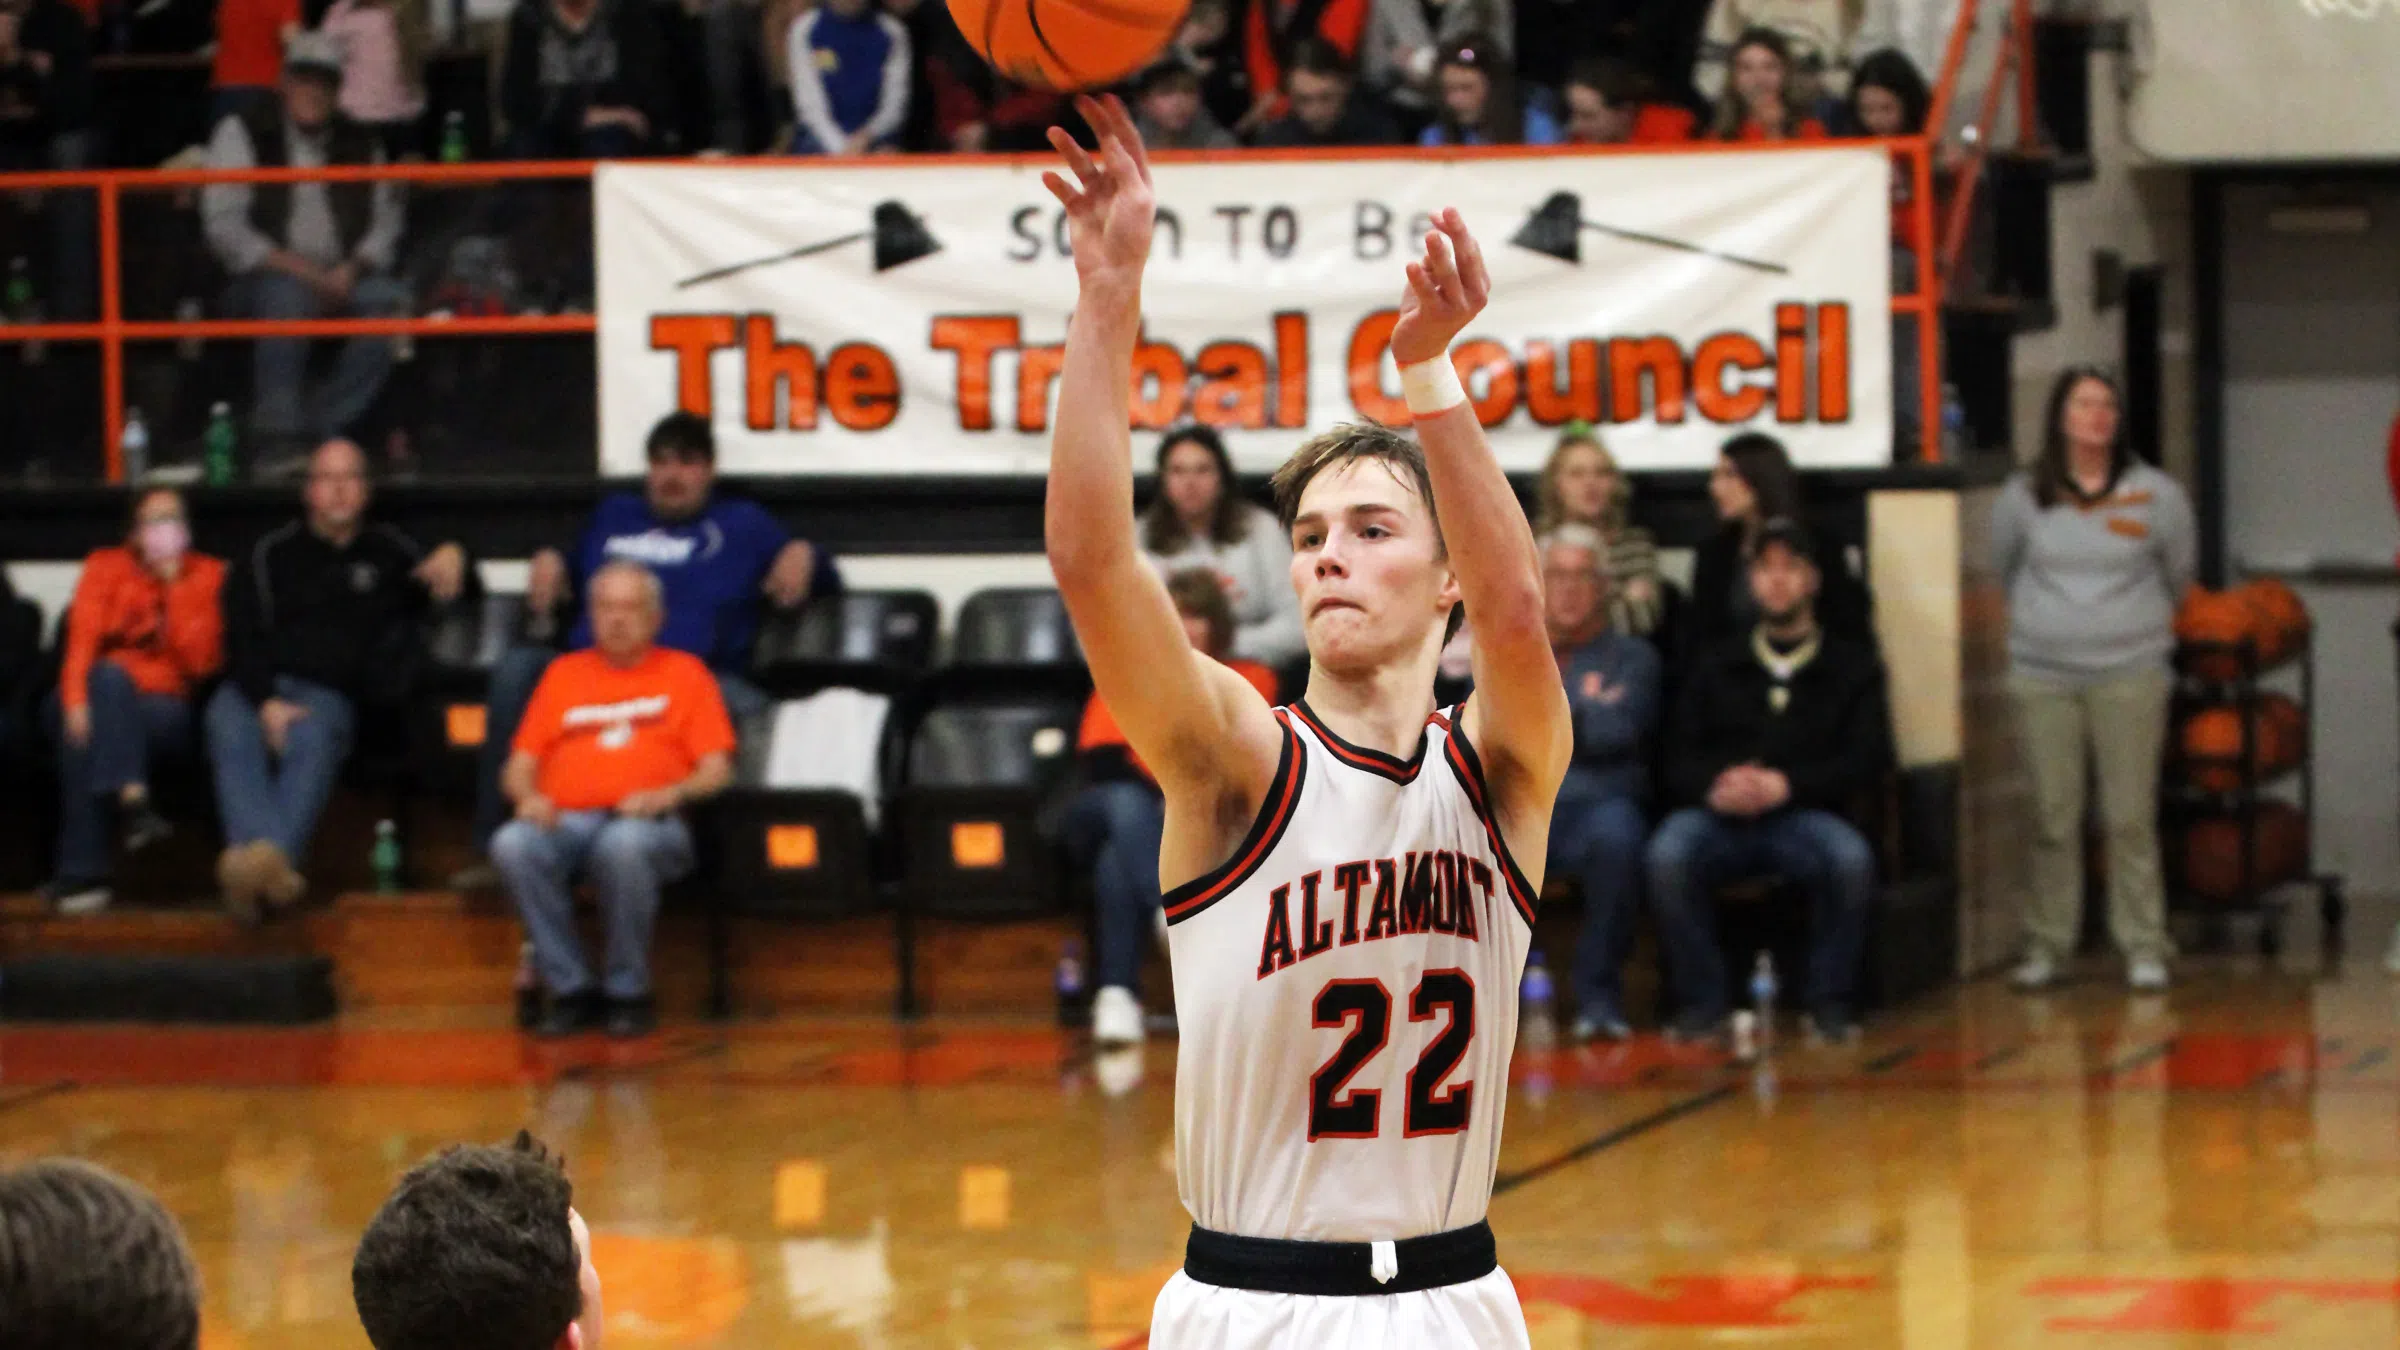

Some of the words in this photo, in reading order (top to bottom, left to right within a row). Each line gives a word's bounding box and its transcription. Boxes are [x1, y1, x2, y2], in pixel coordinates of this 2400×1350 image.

[1009, 204, 1183, 262] Sn
[1355, 199, 1434, 260] Be
[648, 313, 903, 431] The
[930, 312, 1309, 433] Trbal
[1346, 301, 1850, 429] Council
[1257, 848, 1495, 981] ALTAMONT
[1307, 967, 1476, 1142] 22
